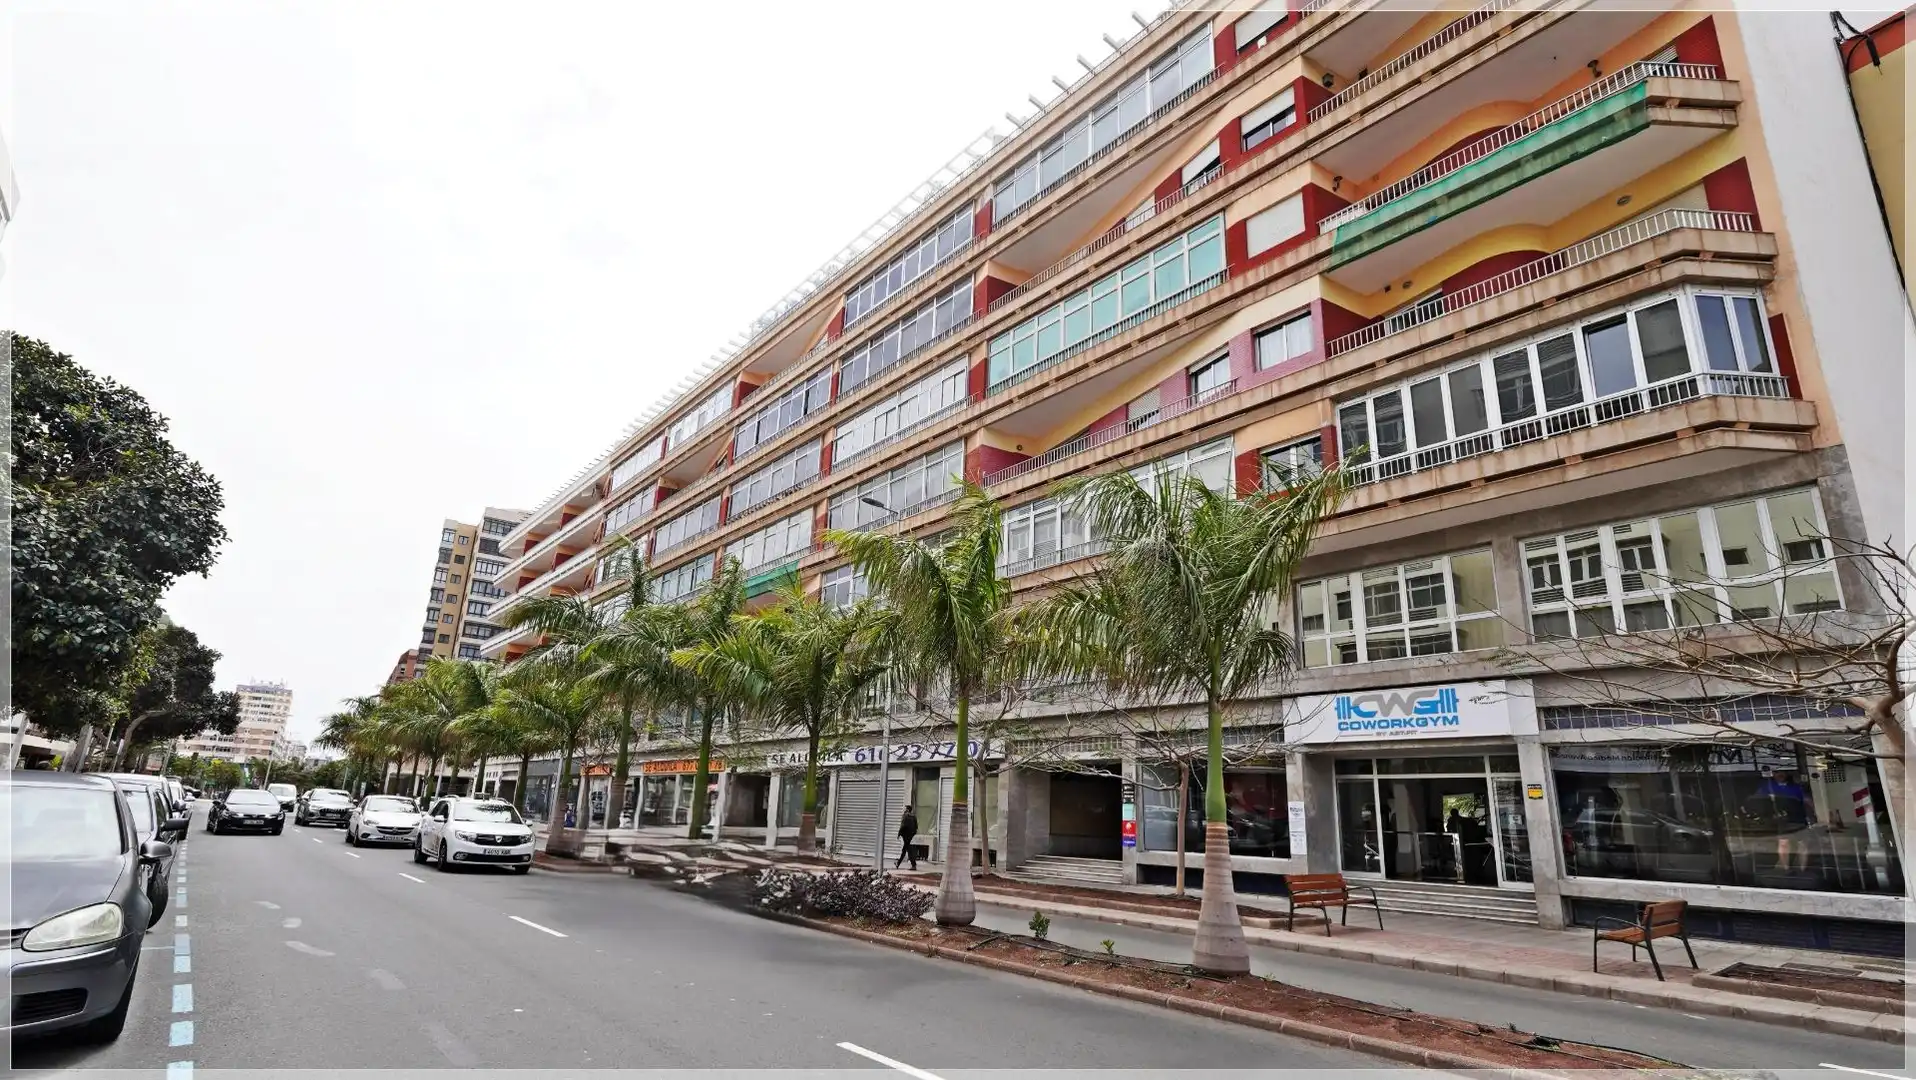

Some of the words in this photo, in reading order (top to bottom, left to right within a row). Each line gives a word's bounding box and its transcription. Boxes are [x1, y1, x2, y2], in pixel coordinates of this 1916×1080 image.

[1351, 688, 1440, 717] CWG
[1338, 715, 1459, 732] COWORKGYM
[771, 754, 786, 764] SE
[896, 744, 923, 761] 23
